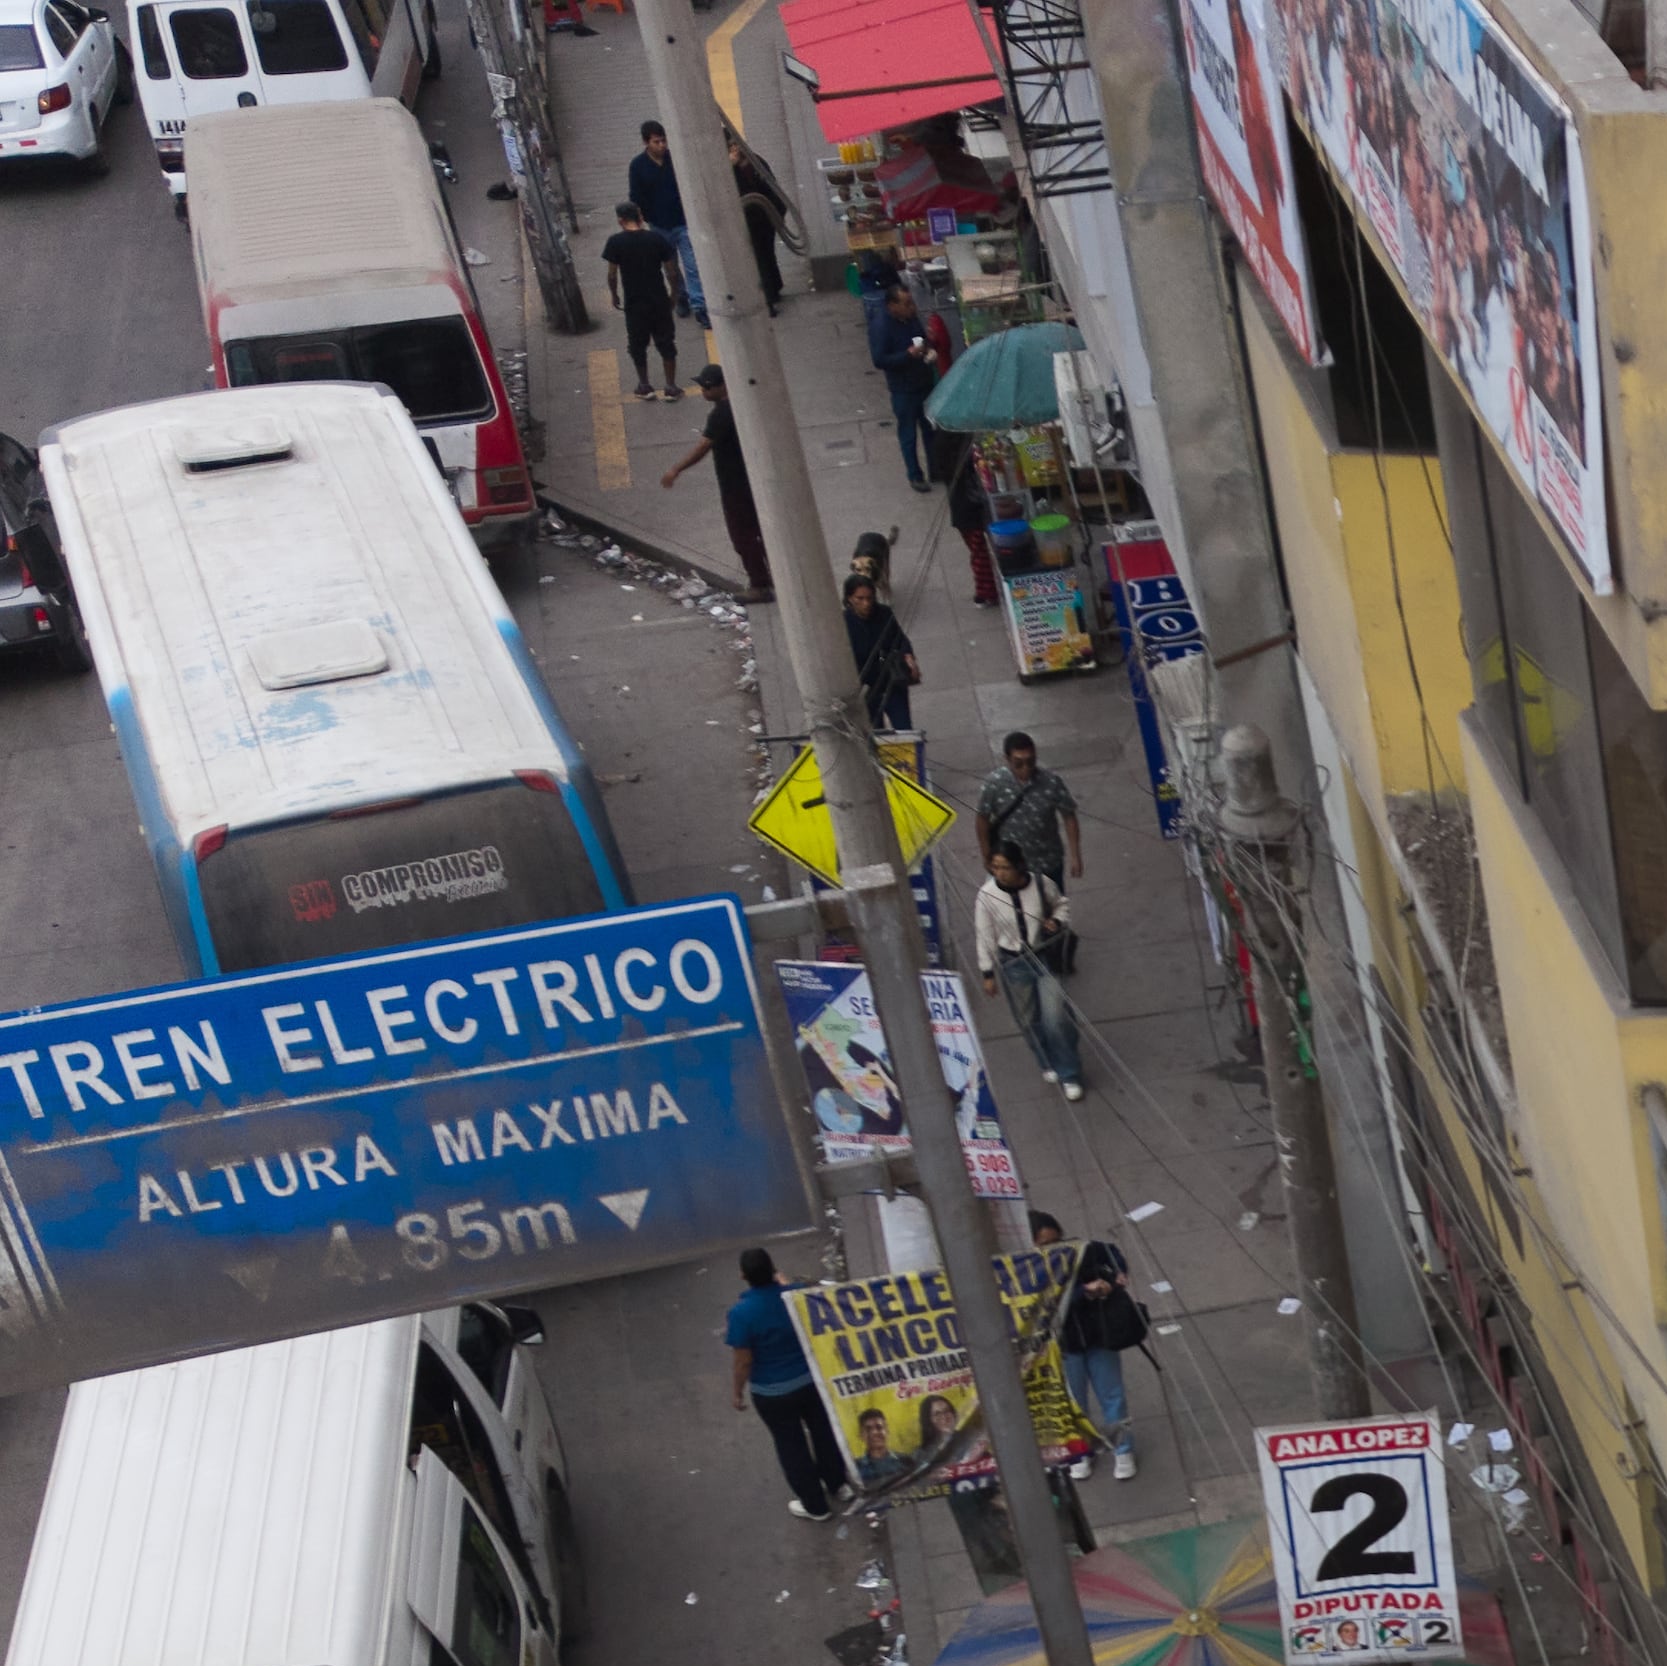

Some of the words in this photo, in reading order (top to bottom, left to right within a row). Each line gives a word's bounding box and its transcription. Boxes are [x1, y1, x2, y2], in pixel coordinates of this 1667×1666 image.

[342, 846, 503, 912] COMPROMISO
[0, 1020, 232, 1119] TREN
[262, 937, 724, 1074] ELECTRICO
[137, 1133, 398, 1224] ALTURA
[431, 1081, 689, 1167] MAXIMA
[832, 1363, 905, 1397] TERMINA
[1276, 1435, 1340, 1458] ANA
[1343, 1426, 1423, 1450] LOPEZ
[1311, 1473, 1416, 1582] 2
[1294, 1592, 1443, 1619] DIPUTADA
[1424, 1621, 1450, 1644] 2
